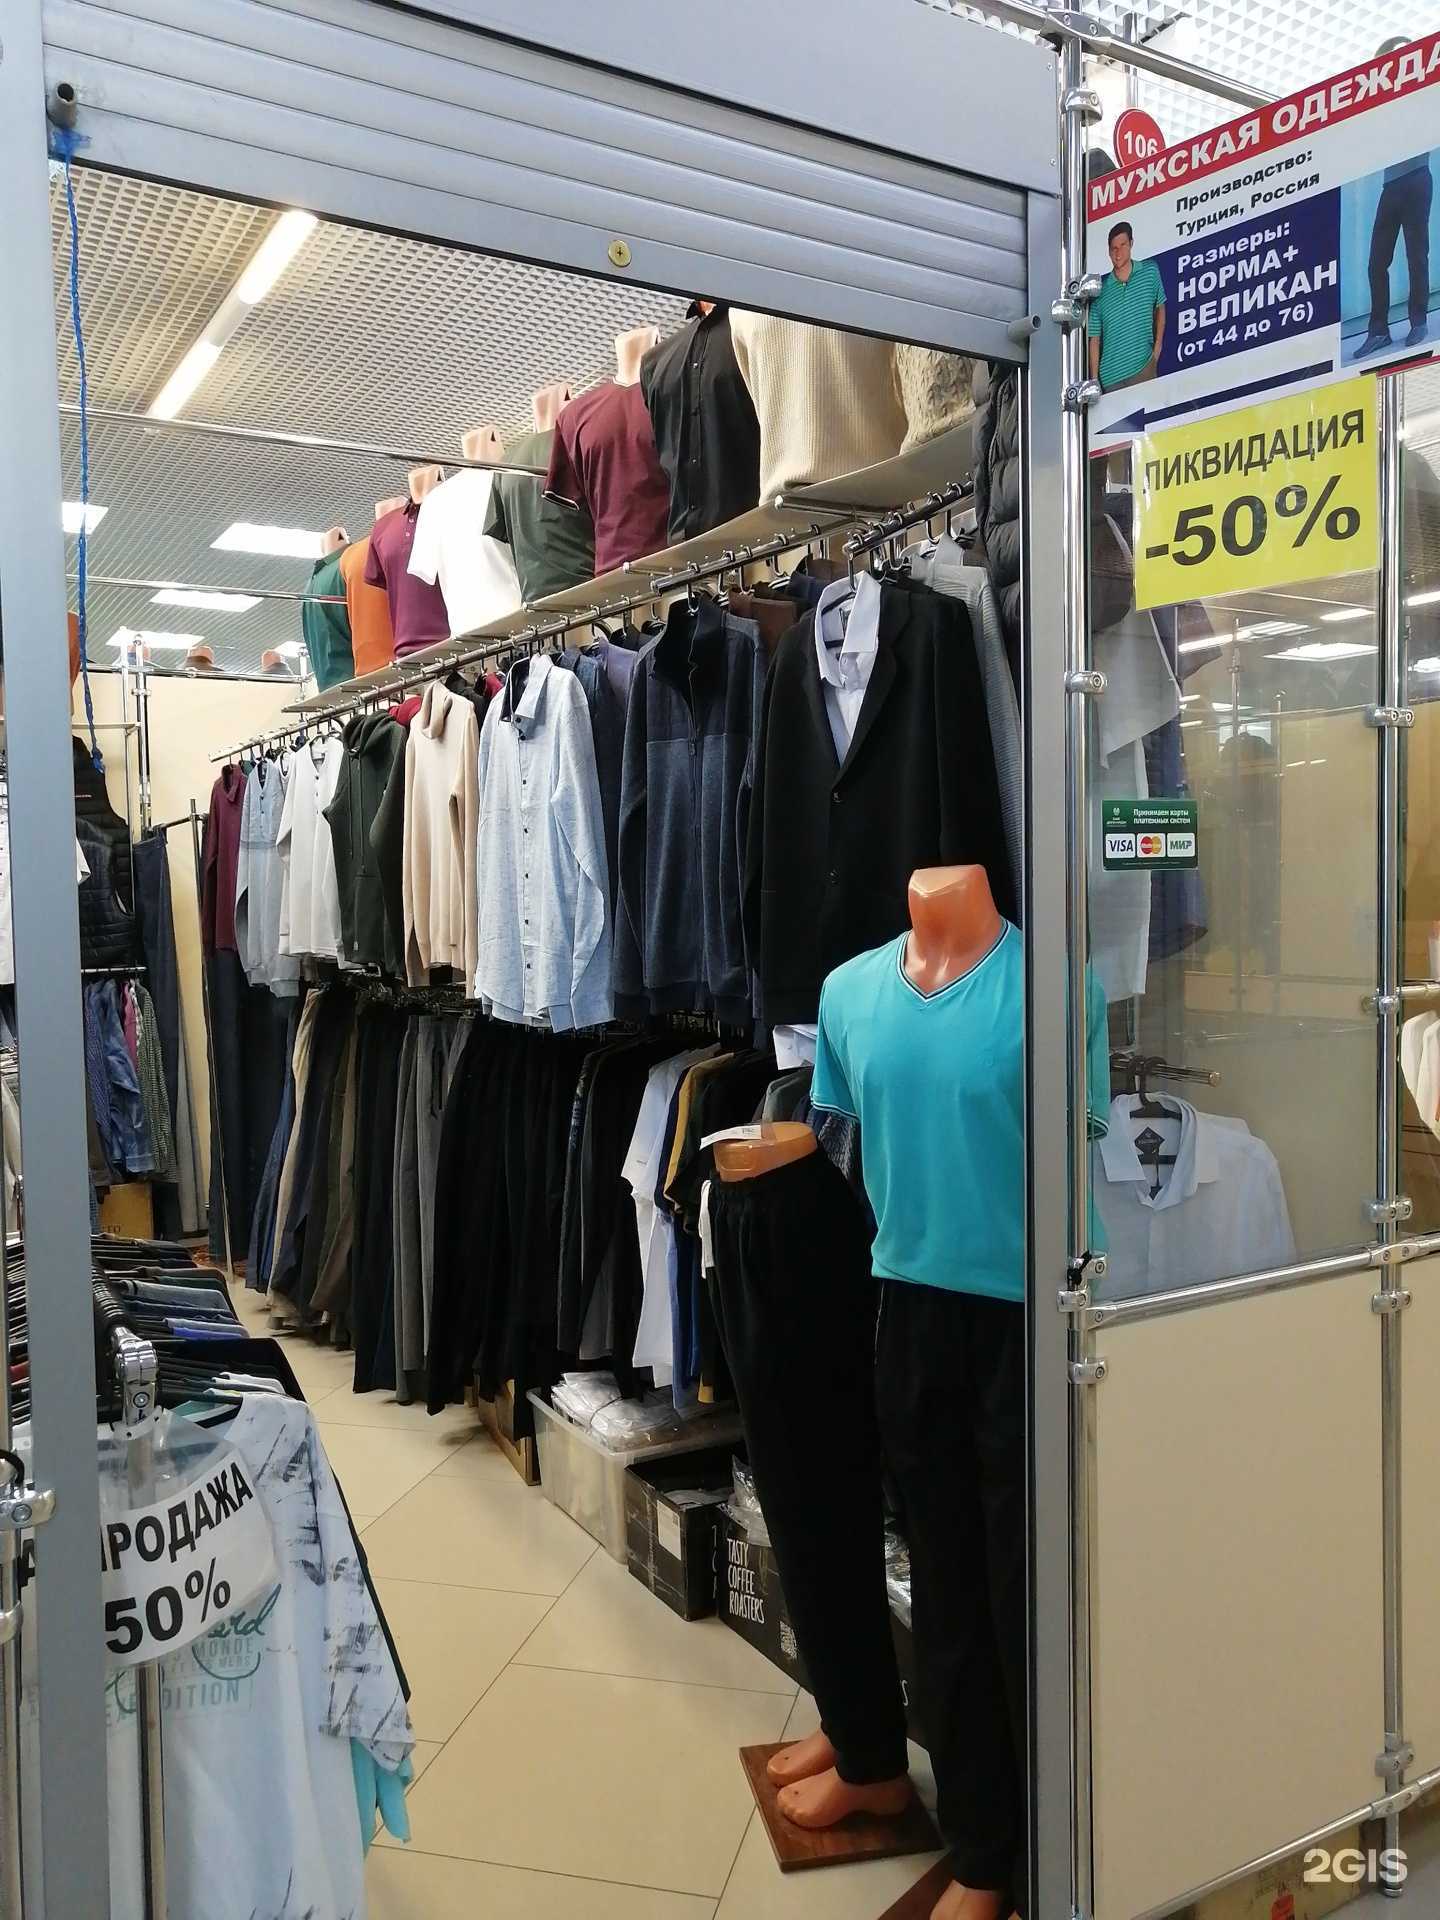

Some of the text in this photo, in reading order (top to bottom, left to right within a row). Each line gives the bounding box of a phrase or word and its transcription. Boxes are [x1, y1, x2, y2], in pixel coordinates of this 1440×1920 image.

[1092, 117, 1261, 211] МУЖСКАЯ
[1176, 150, 1313, 213] Производство:
[1175, 173, 1320, 237] Турция, Россия
[1177, 221, 1290, 274] Размеры:
[1178, 244, 1299, 302] НОРМА+
[1178, 260, 1337, 335] ВЕЛИКАН
[1177, 301, 1314, 362] (от 44 до 76)
[1145, 474, 1361, 566] -50%
[1108, 840, 1134, 852] VISA
[1170, 840, 1193, 850] МИР
[101, 1462, 254, 1572] РОДАЖА
[727, 1538, 749, 1567] TASTY
[728, 1564, 755, 1595] COFFEE
[729, 1590, 765, 1624] ROASTERS
